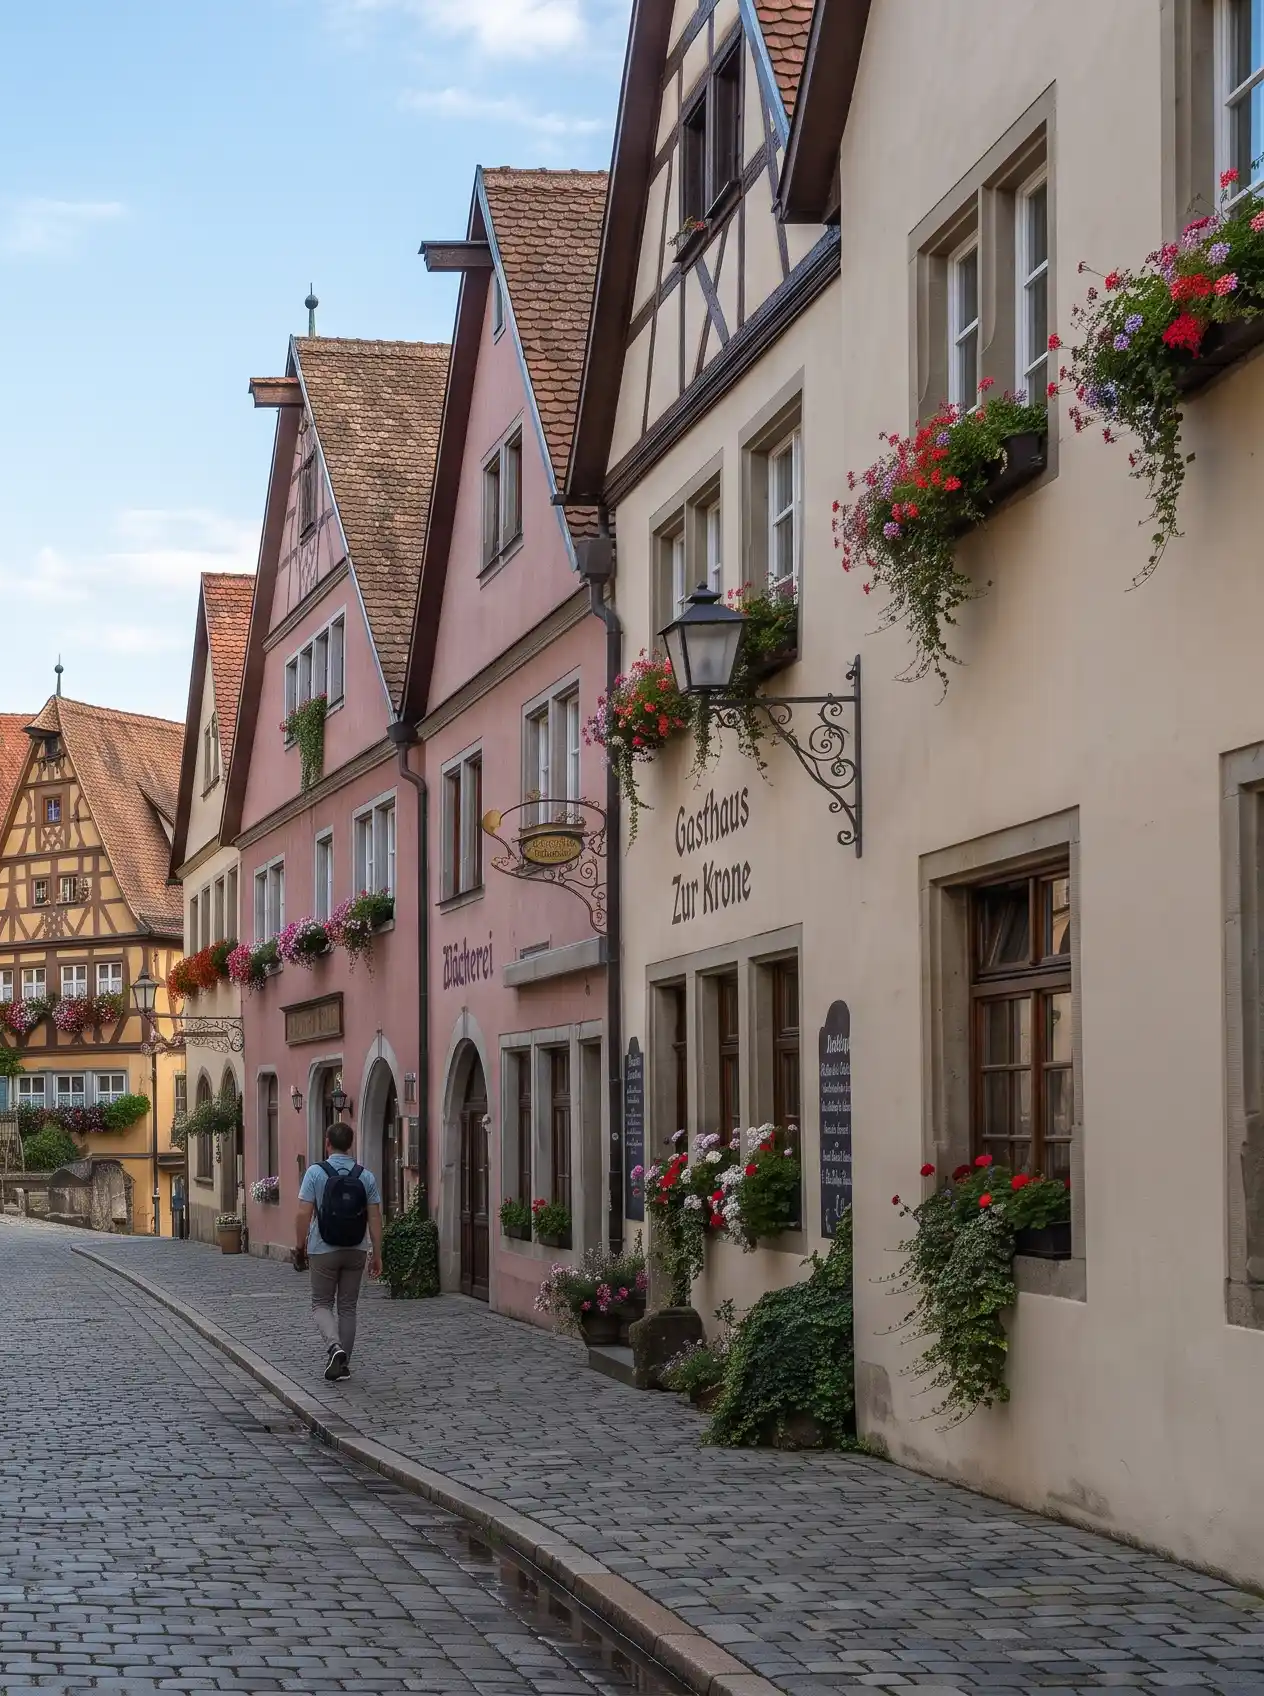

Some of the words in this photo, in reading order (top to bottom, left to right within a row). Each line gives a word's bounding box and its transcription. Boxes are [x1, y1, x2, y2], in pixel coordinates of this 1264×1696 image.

[675, 786, 749, 857] Gasthaus
[671, 873, 698, 925] Zur
[702, 860, 752, 915] Krone
